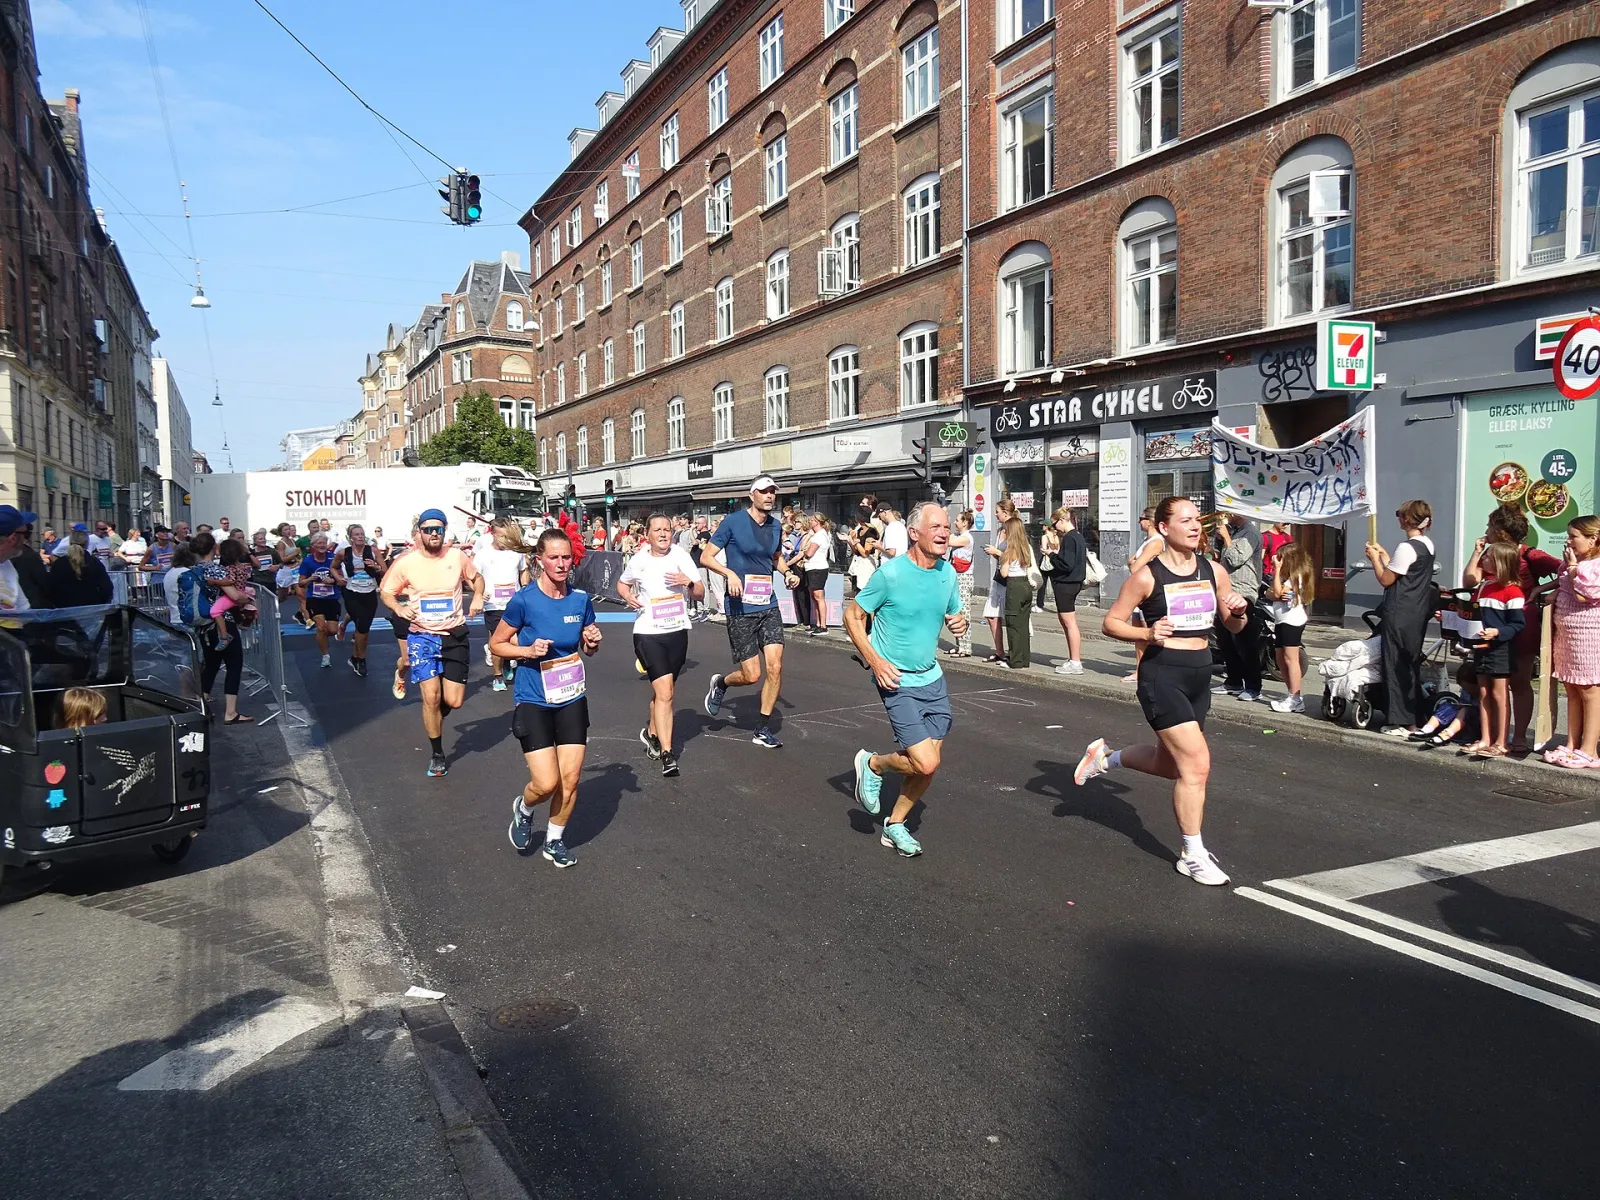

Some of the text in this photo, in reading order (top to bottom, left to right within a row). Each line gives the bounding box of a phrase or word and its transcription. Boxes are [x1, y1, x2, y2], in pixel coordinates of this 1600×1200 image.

[1338, 333, 1364, 384] 7
[1563, 343, 1600, 375] 40
[1029, 384, 1164, 428] STAR CYKEL
[1489, 399, 1575, 417] GRÆSK, KYLLING
[1489, 416, 1553, 433] ELLER LAKS?
[285, 489, 367, 507] STOKHOLM
[1282, 477, 1329, 516] KOM
[1183, 599, 1204, 609] JULIE
